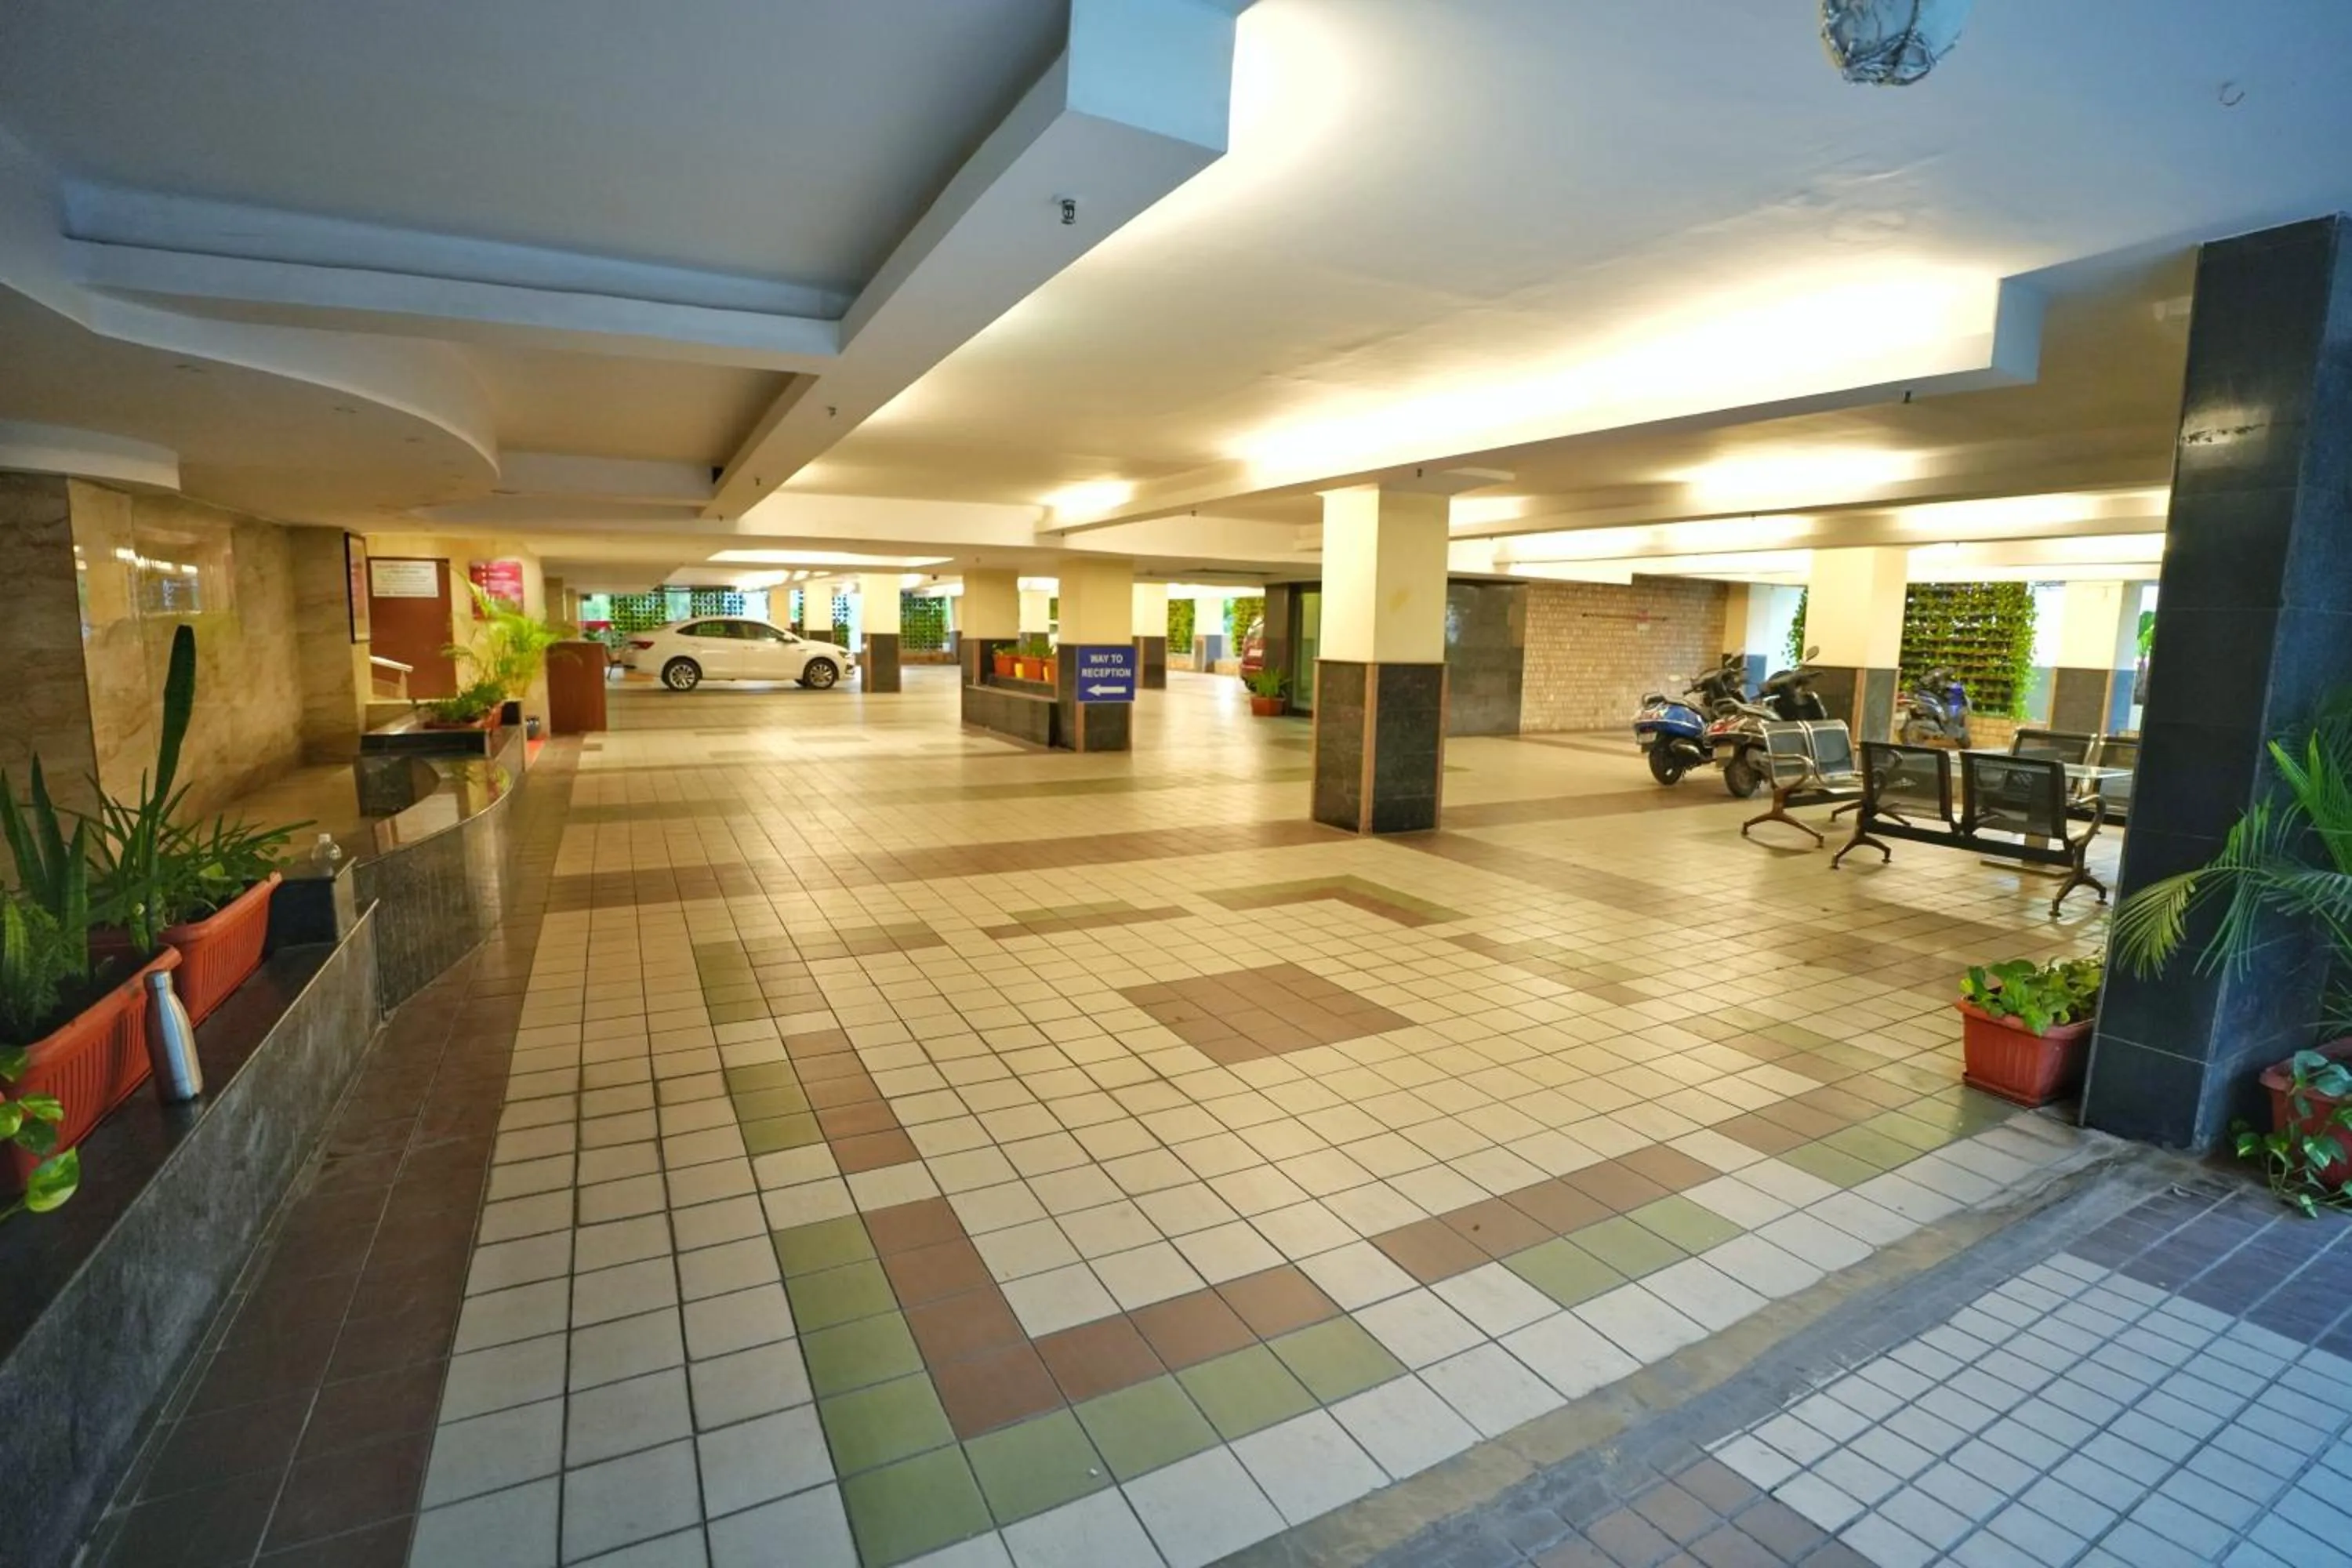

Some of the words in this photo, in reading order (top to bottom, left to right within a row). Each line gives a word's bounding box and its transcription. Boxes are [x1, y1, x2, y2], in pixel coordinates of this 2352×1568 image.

[1090, 654, 1109, 663] WAY
[1110, 653, 1123, 663] TO
[1081, 667, 1131, 678] RECEPTION
